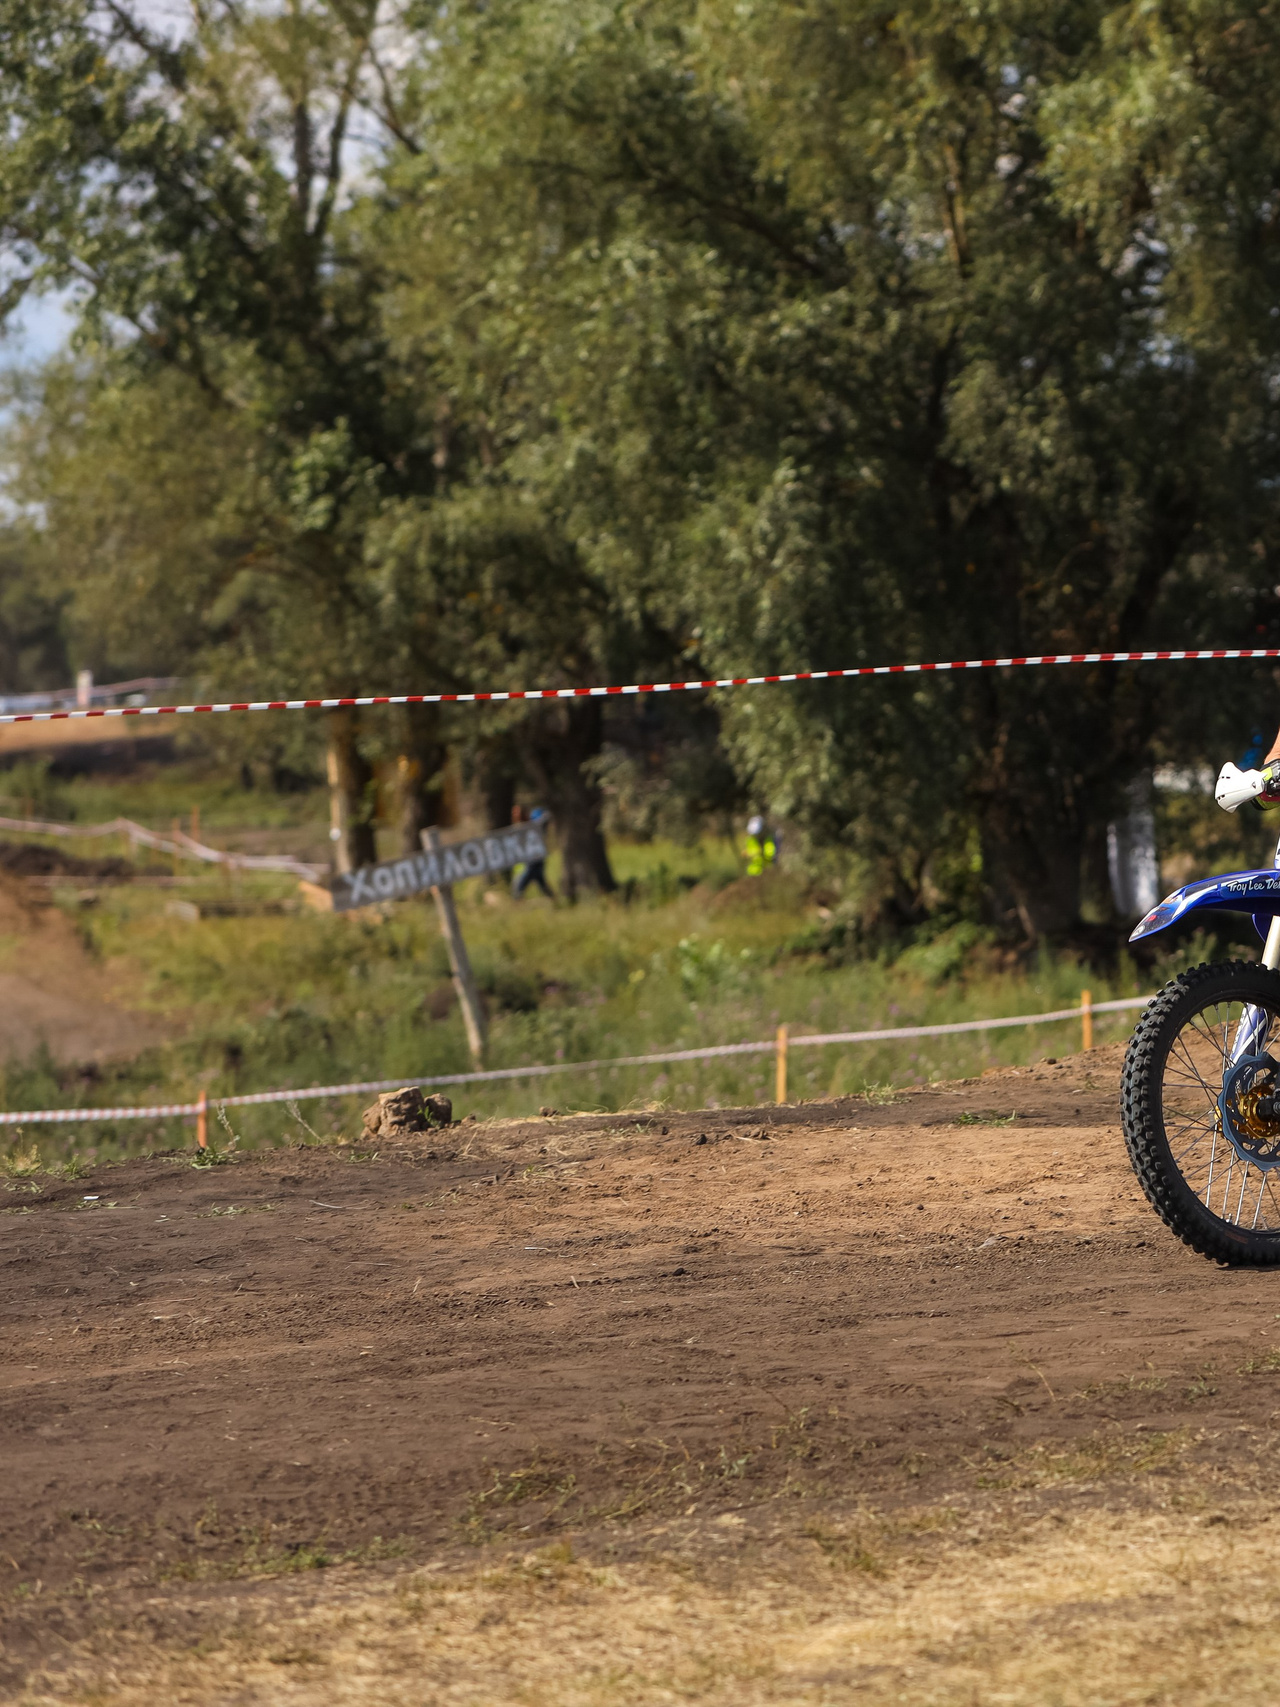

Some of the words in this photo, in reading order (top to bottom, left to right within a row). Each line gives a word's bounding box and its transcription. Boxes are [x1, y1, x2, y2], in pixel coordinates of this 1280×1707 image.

[344, 828, 547, 904] ХОПИЛОВКА
[1227, 881, 1247, 895] Troy
[1248, 880, 1265, 890] Lee
